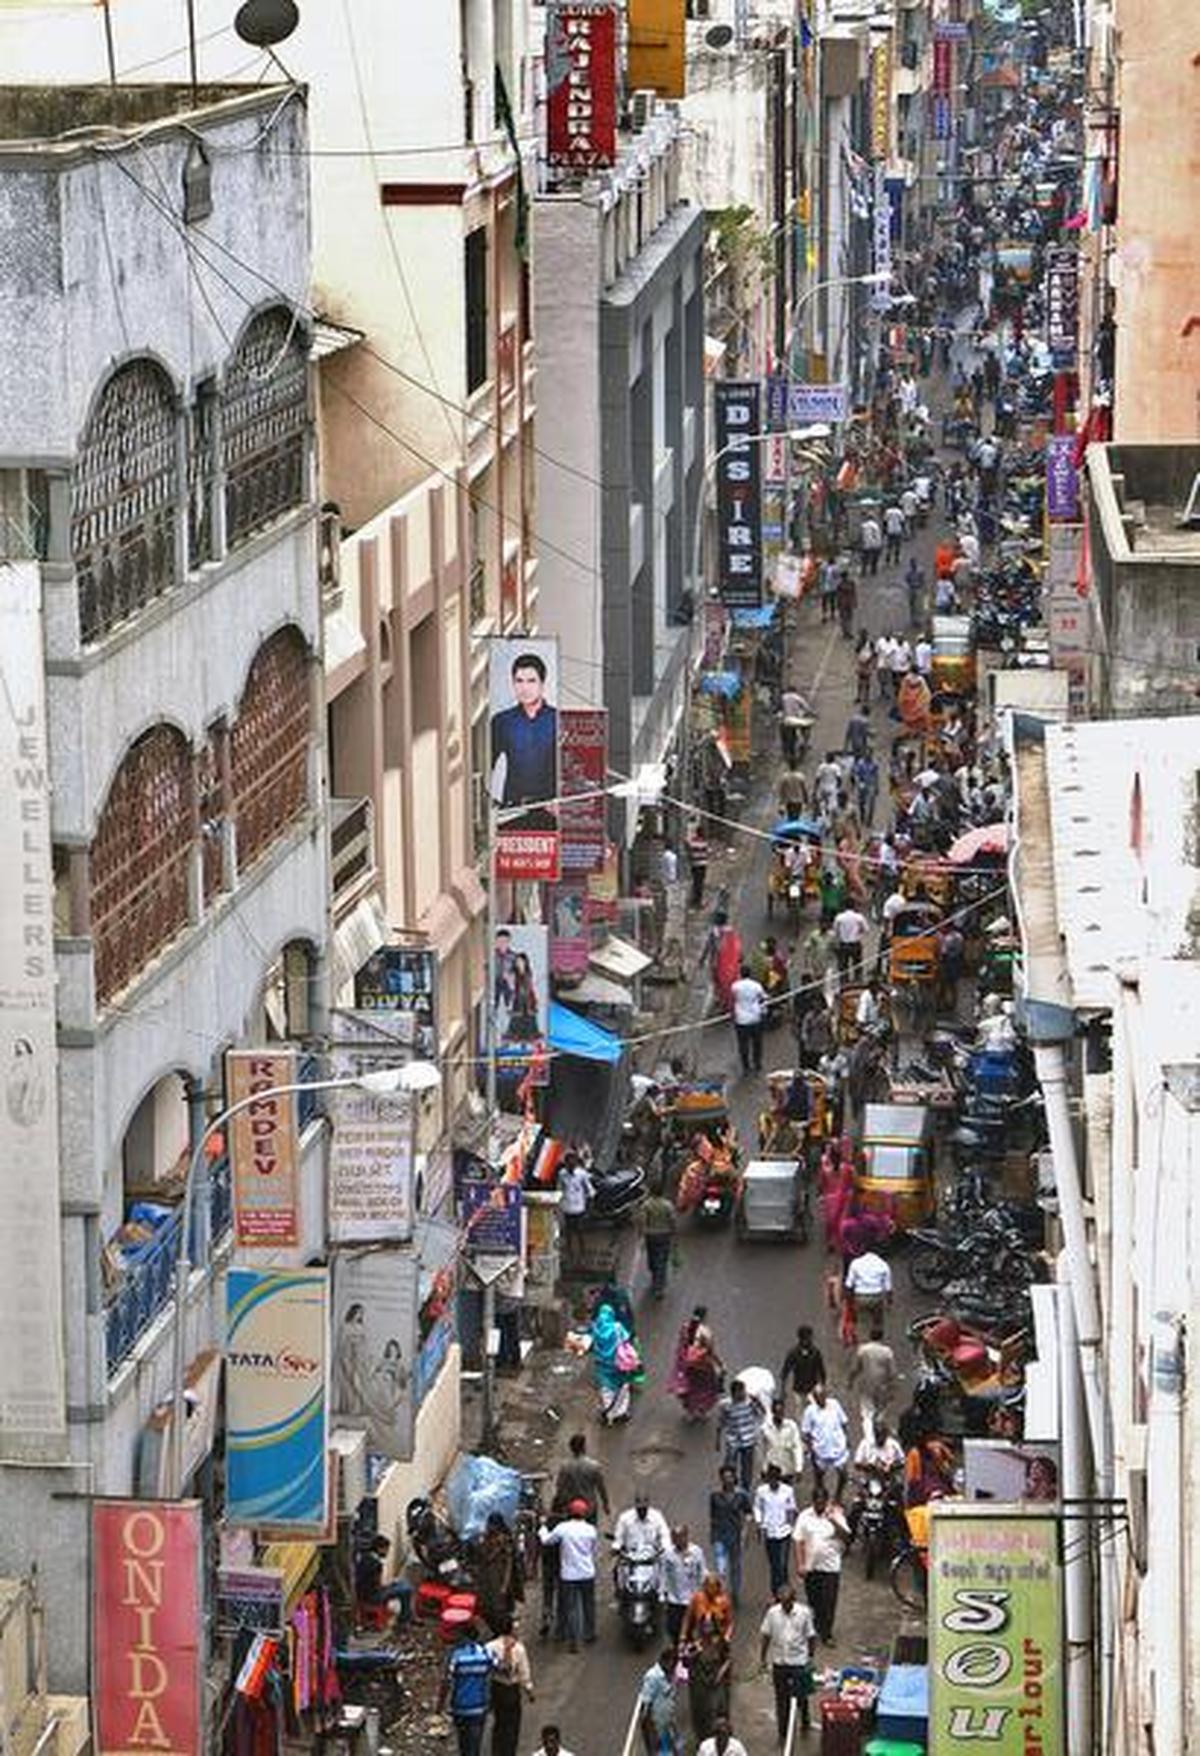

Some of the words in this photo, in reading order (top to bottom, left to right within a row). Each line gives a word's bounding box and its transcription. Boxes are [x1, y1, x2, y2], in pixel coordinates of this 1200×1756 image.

[567, 20, 592, 150] RAJENDRA
[550, 153, 611, 166] PLAZA
[725, 404, 753, 573] DESIRE
[14, 706, 45, 978] JEWELLERS
[361, 994, 430, 1011] DIVYA
[249, 1060, 278, 1175] RAMDEV
[228, 1353, 274, 1366] TATA
[121, 1510, 172, 1748] ONIDA
